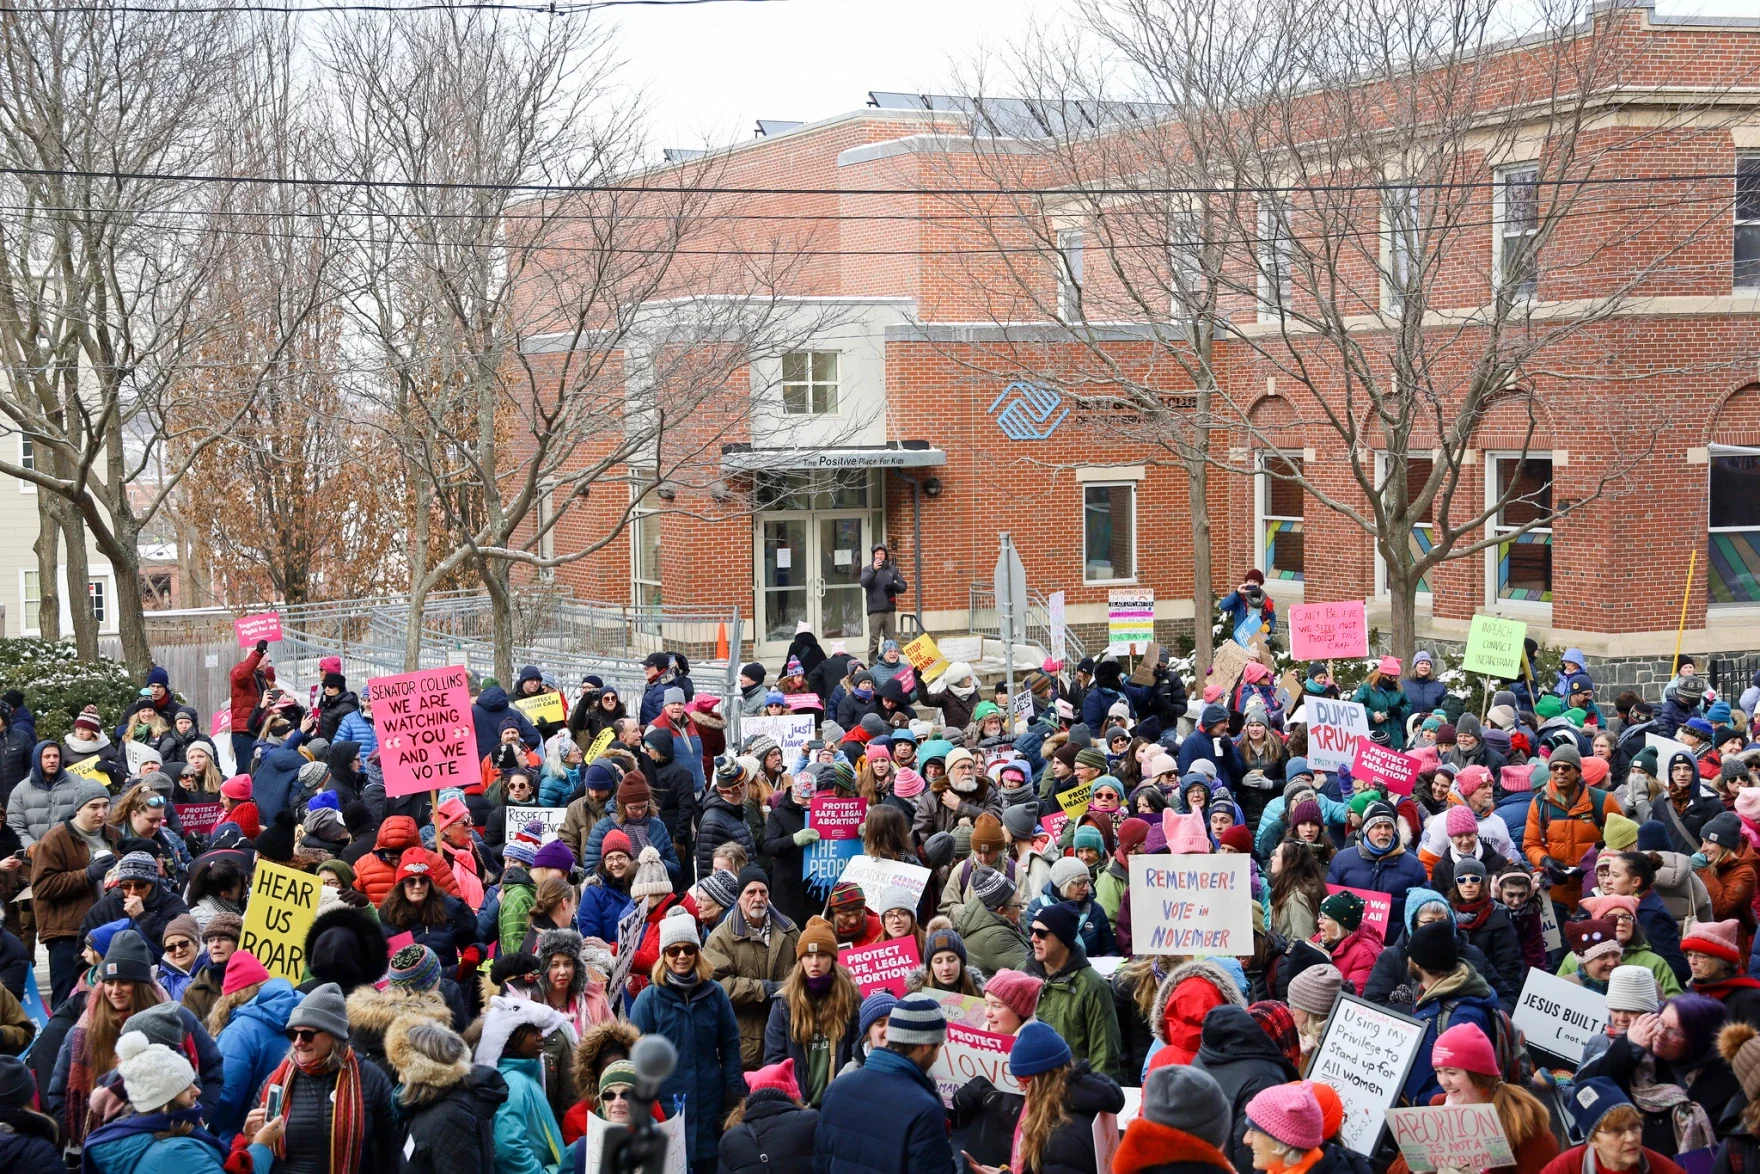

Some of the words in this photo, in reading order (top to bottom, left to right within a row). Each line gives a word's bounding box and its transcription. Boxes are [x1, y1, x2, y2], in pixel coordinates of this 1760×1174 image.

[803, 458, 817, 467] The
[818, 455, 857, 466] Positive
[891, 457, 904, 465] Kids
[238, 620, 267, 630] Together
[241, 628, 259, 636] Fight
[1298, 625, 1312, 633] WE
[1315, 623, 1337, 632] STILL
[1338, 621, 1357, 630] MUST
[1481, 622, 1513, 638] IMPEACH
[1308, 634, 1336, 643] PROTEST
[1341, 632, 1358, 640] THIS
[1482, 640, 1513, 652] CONVICT
[1475, 653, 1516, 668] INCARCERATE
[372, 680, 417, 701] SENATOR
[420, 673, 464, 693] COLLINS
[389, 698, 411, 715] WE
[419, 693, 451, 710] ARE
[524, 696, 552, 705] PROTECT
[383, 709, 460, 733] WATCHING
[1315, 702, 1359, 727] DUMP
[407, 728, 446, 746] YOU
[744, 717, 785, 737] Girls
[788, 718, 814, 738] just
[781, 735, 805, 748] have
[399, 748, 428, 766] AND
[439, 741, 467, 758] WE
[1314, 758, 1331, 767] TRUTH
[1361, 751, 1383, 767] SAFE,
[1385, 761, 1413, 776] LEGAL
[1370, 747, 1409, 766] PROTECT
[411, 760, 459, 780] VOTE
[1361, 760, 1408, 782] ABORTION
[184, 806, 218, 814] PROTECT
[509, 808, 554, 823] RESPECT
[815, 810, 839, 818] SAFE,
[823, 802, 859, 810] PROTECT
[181, 818, 216, 827] BORTION
[811, 840, 838, 858] THE
[809, 858, 849, 878] PEOP
[257, 869, 314, 909] HEAR
[1146, 868, 1235, 892] REMEMBER!
[1163, 899, 1195, 921] VOTE
[1370, 900, 1386, 910] We
[266, 906, 293, 934] US
[1367, 912, 1383, 922] All
[1150, 925, 1230, 949] NOVEMBER
[242, 931, 303, 980] ROAR
[847, 945, 900, 965] PROTECT
[848, 964, 873, 976] AFE,
[876, 955, 912, 970] LEGAL
[855, 966, 910, 985] BORTION
[1523, 993, 1561, 1017] JESUS
[1562, 1008, 1599, 1032] BUILT
[1345, 1008, 1380, 1039] Using
[950, 1028, 1002, 1049] PROTECT
[1335, 1024, 1381, 1056] Privilege
[1384, 1048, 1399, 1063] to
[1564, 1034, 1579, 1043] not
[944, 1046, 1019, 1088] love
[1329, 1042, 1358, 1065] Stand
[1362, 1059, 1375, 1075] up
[1376, 1061, 1396, 1079] for
[1321, 1059, 1341, 1076] All
[1343, 1069, 1384, 1096] women
[1395, 1108, 1499, 1144] ABORTION
[1426, 1143, 1445, 1154] IS
[1449, 1140, 1472, 1153] NOT
[1475, 1139, 1483, 1149] A
[1428, 1152, 1494, 1169] PROBLEM
